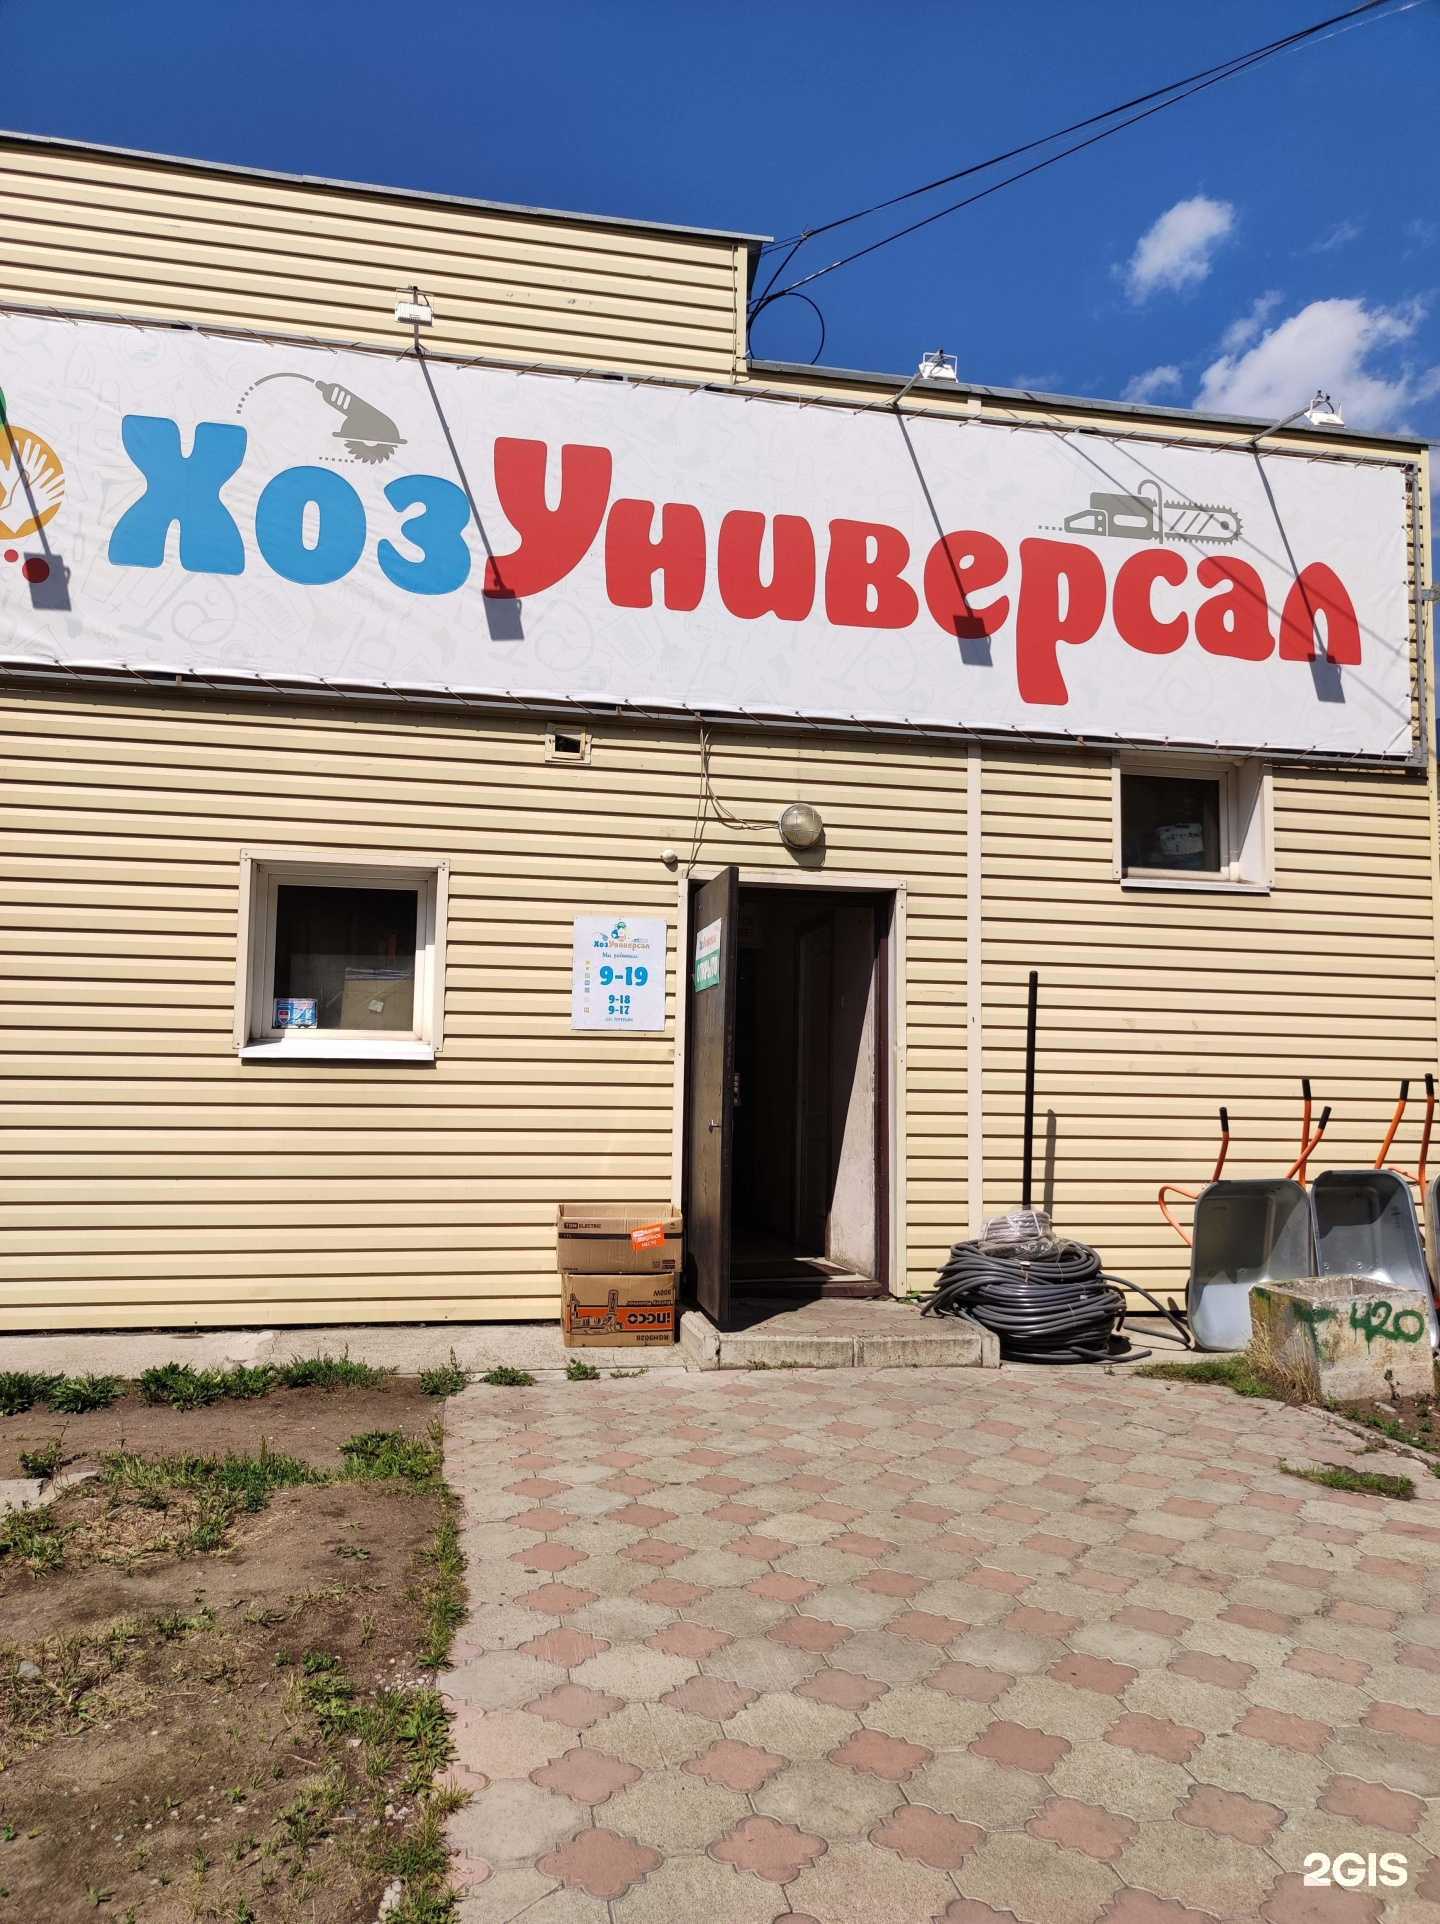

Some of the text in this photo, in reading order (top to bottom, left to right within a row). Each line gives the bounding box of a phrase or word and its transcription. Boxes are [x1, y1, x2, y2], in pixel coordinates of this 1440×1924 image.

[108, 414, 1361, 705] ХозУниверсал
[600, 966, 648, 986] 9-19
[608, 994, 631, 1004] 9-18
[608, 1005, 630, 1015] 9-17
[1351, 1301, 1424, 1343] 420
